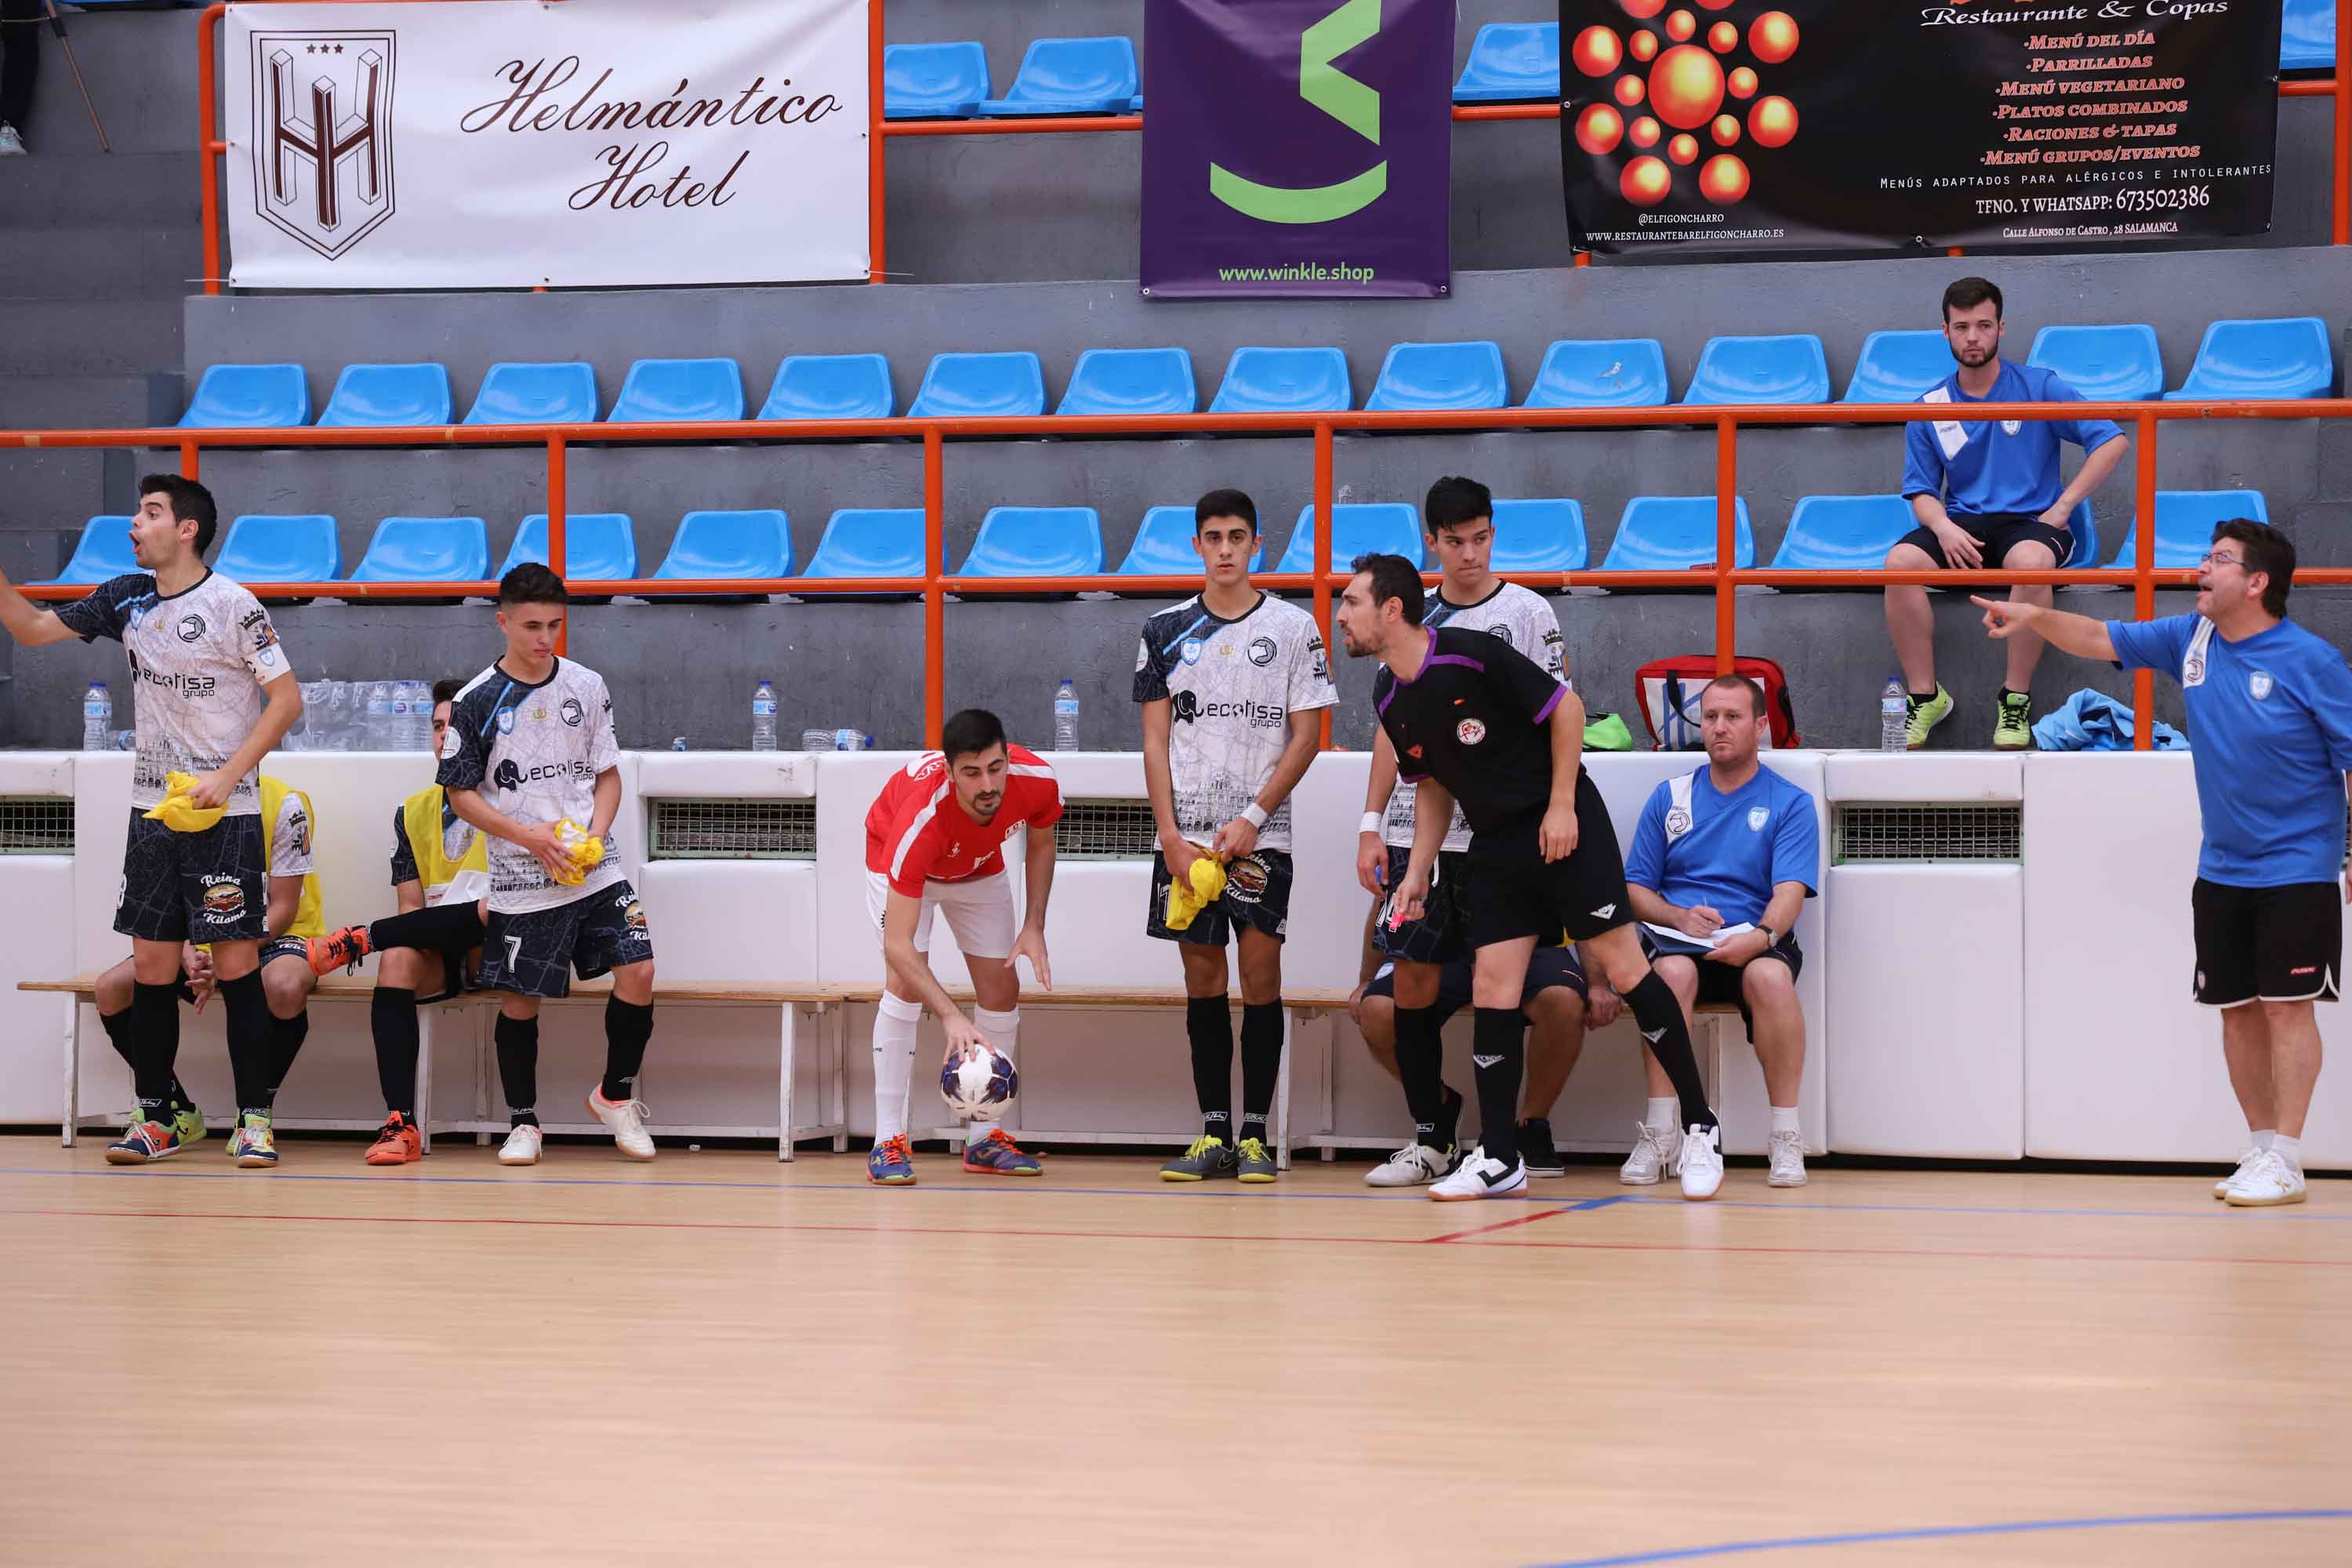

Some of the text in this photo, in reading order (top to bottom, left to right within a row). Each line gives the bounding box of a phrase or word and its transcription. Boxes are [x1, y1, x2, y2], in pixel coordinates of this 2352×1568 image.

[1920, 0, 2227, 27] Restaurante & Copas
[460, 56, 843, 132] Helmántico
[568, 141, 750, 211] Hotel
[1975, 184, 2210, 214] TFNO. Y WHATSAPP: 673502386
[1218, 261, 1374, 284] www.winkle.shop
[183, 690, 215, 699] grupo
[1207, 699, 1283, 720] ecotisa
[1250, 718, 1281, 729] grupo
[1245, 853, 1272, 874] eina
[200, 872, 241, 887] Reina
[615, 891, 636, 908] Rei
[203, 909, 247, 924] Kilama
[504, 935, 522, 973] 7
